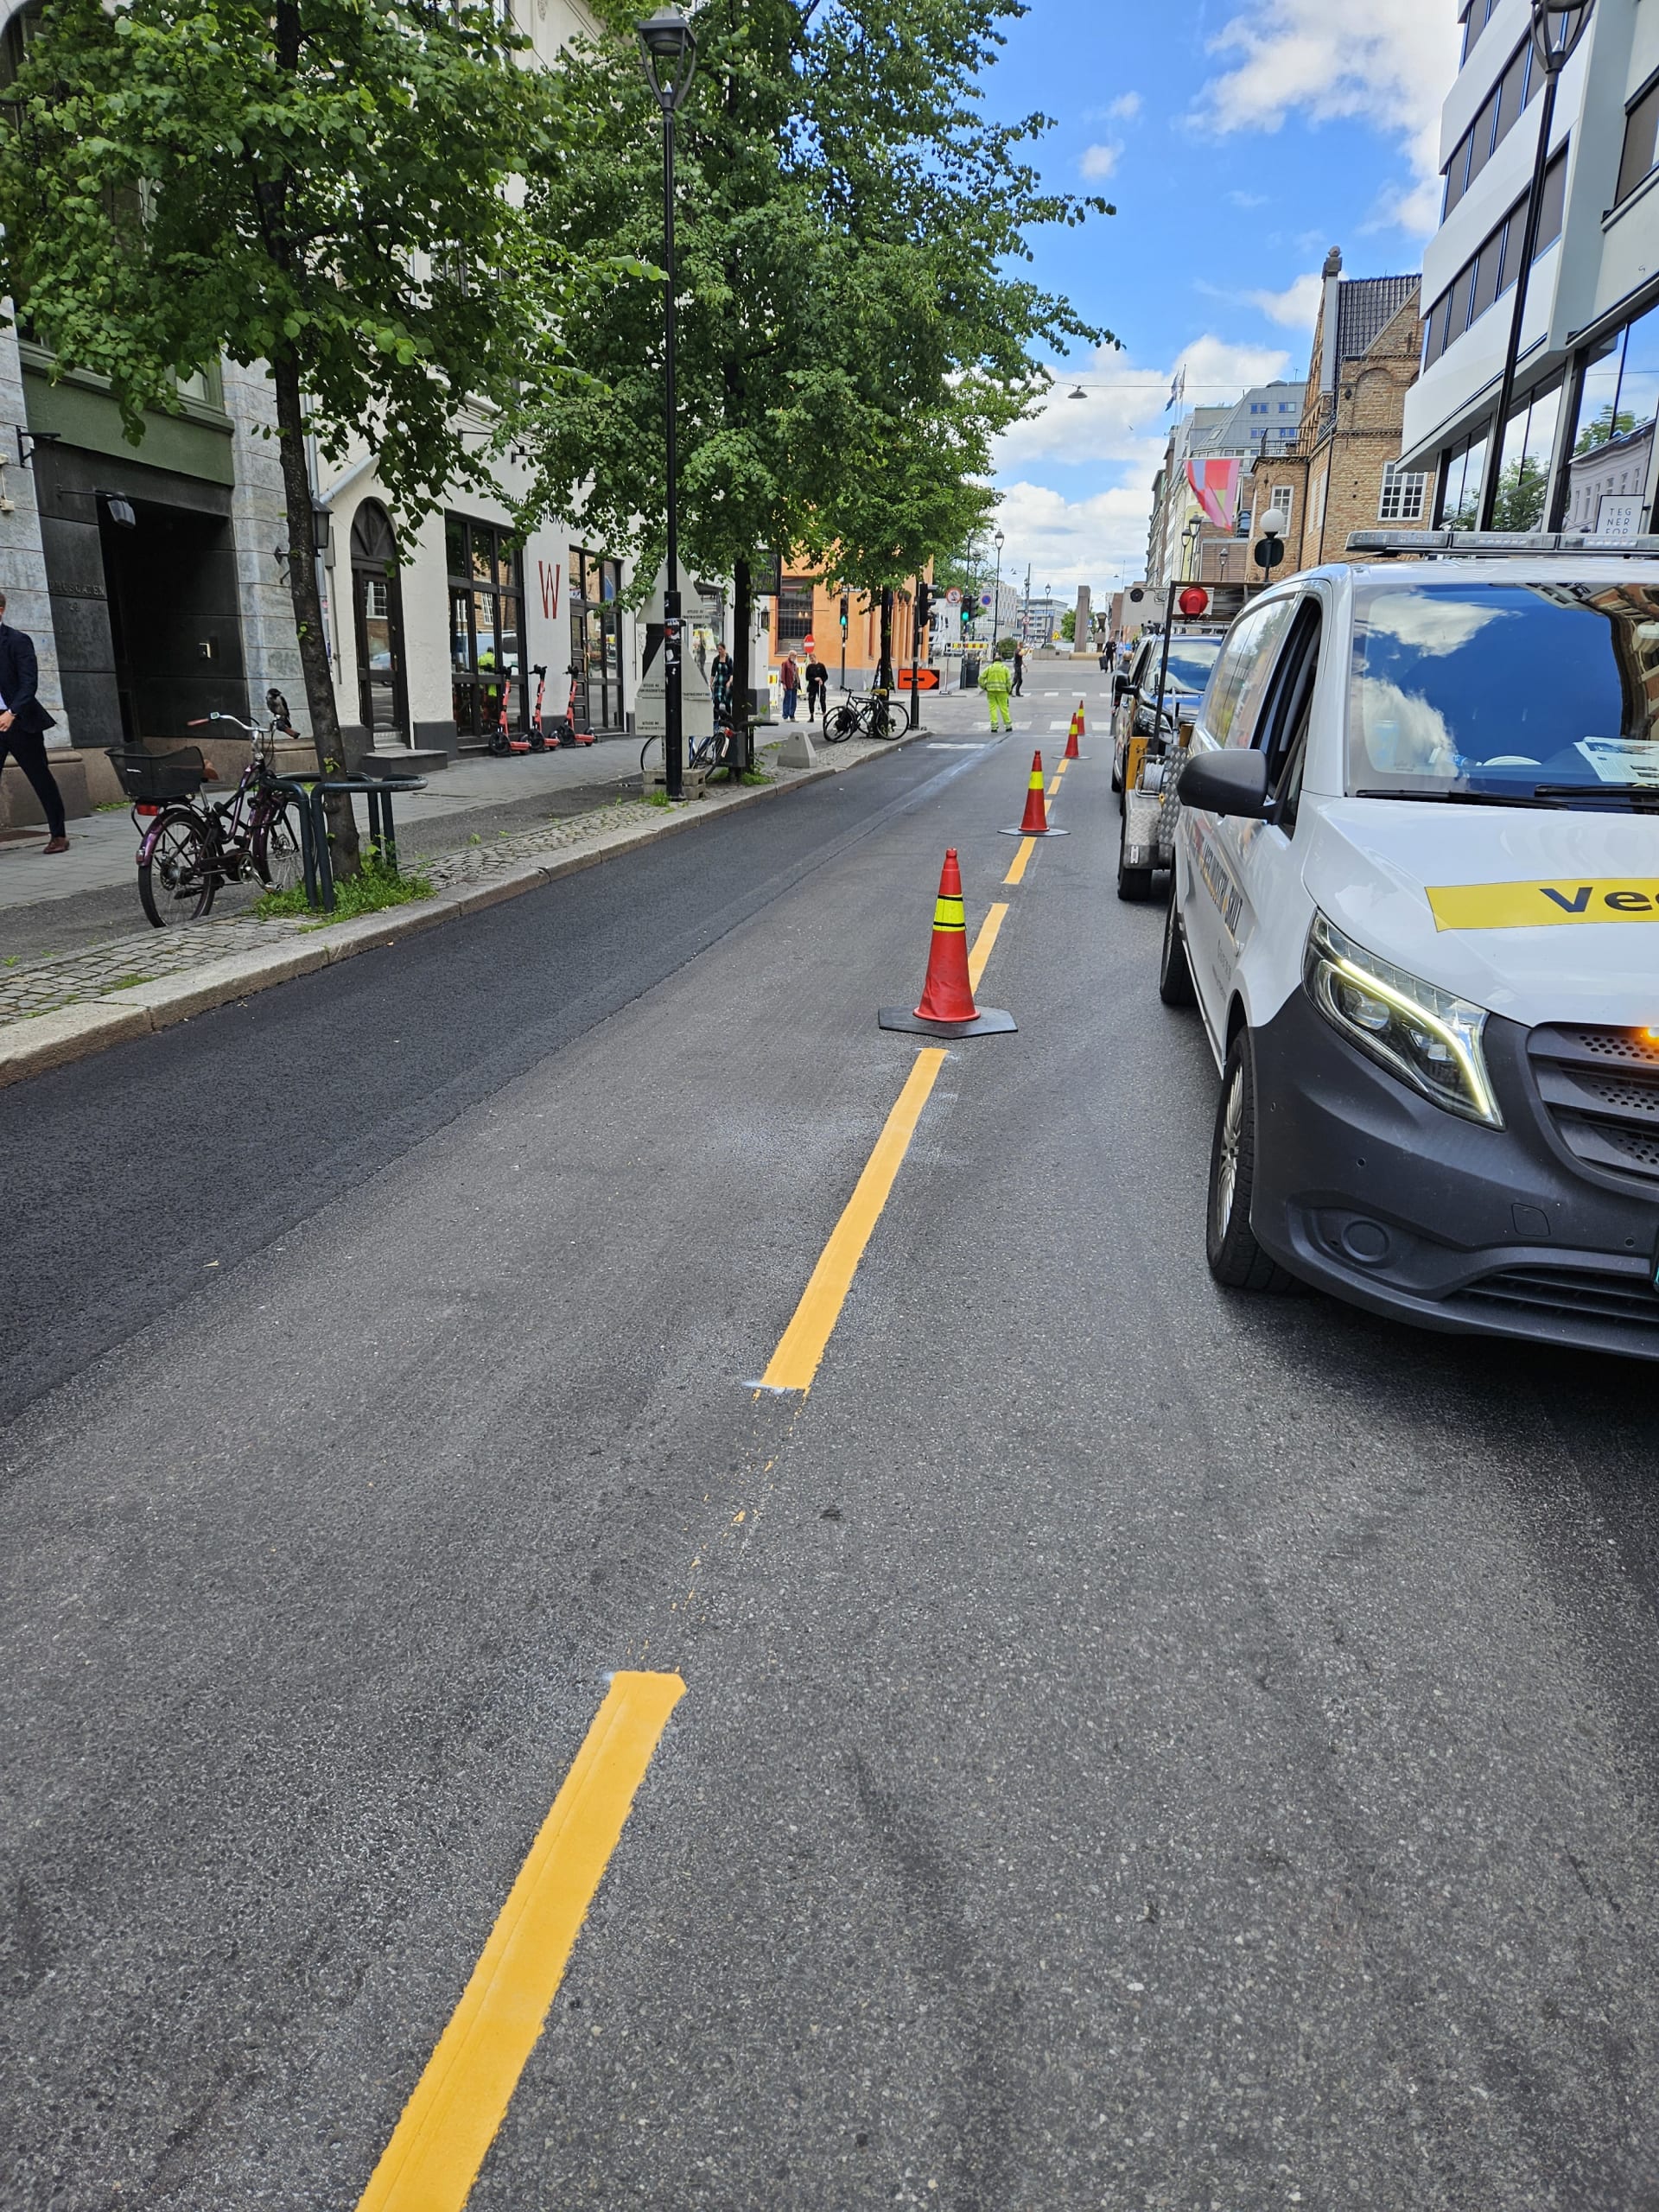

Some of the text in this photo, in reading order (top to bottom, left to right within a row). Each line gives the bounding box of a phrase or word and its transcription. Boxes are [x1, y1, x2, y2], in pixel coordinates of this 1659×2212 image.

[1610, 507, 1631, 516] TEG
[1607, 518, 1630, 526] NER
[538, 560, 561, 620] W
[1539, 887, 1659, 912] Ve
